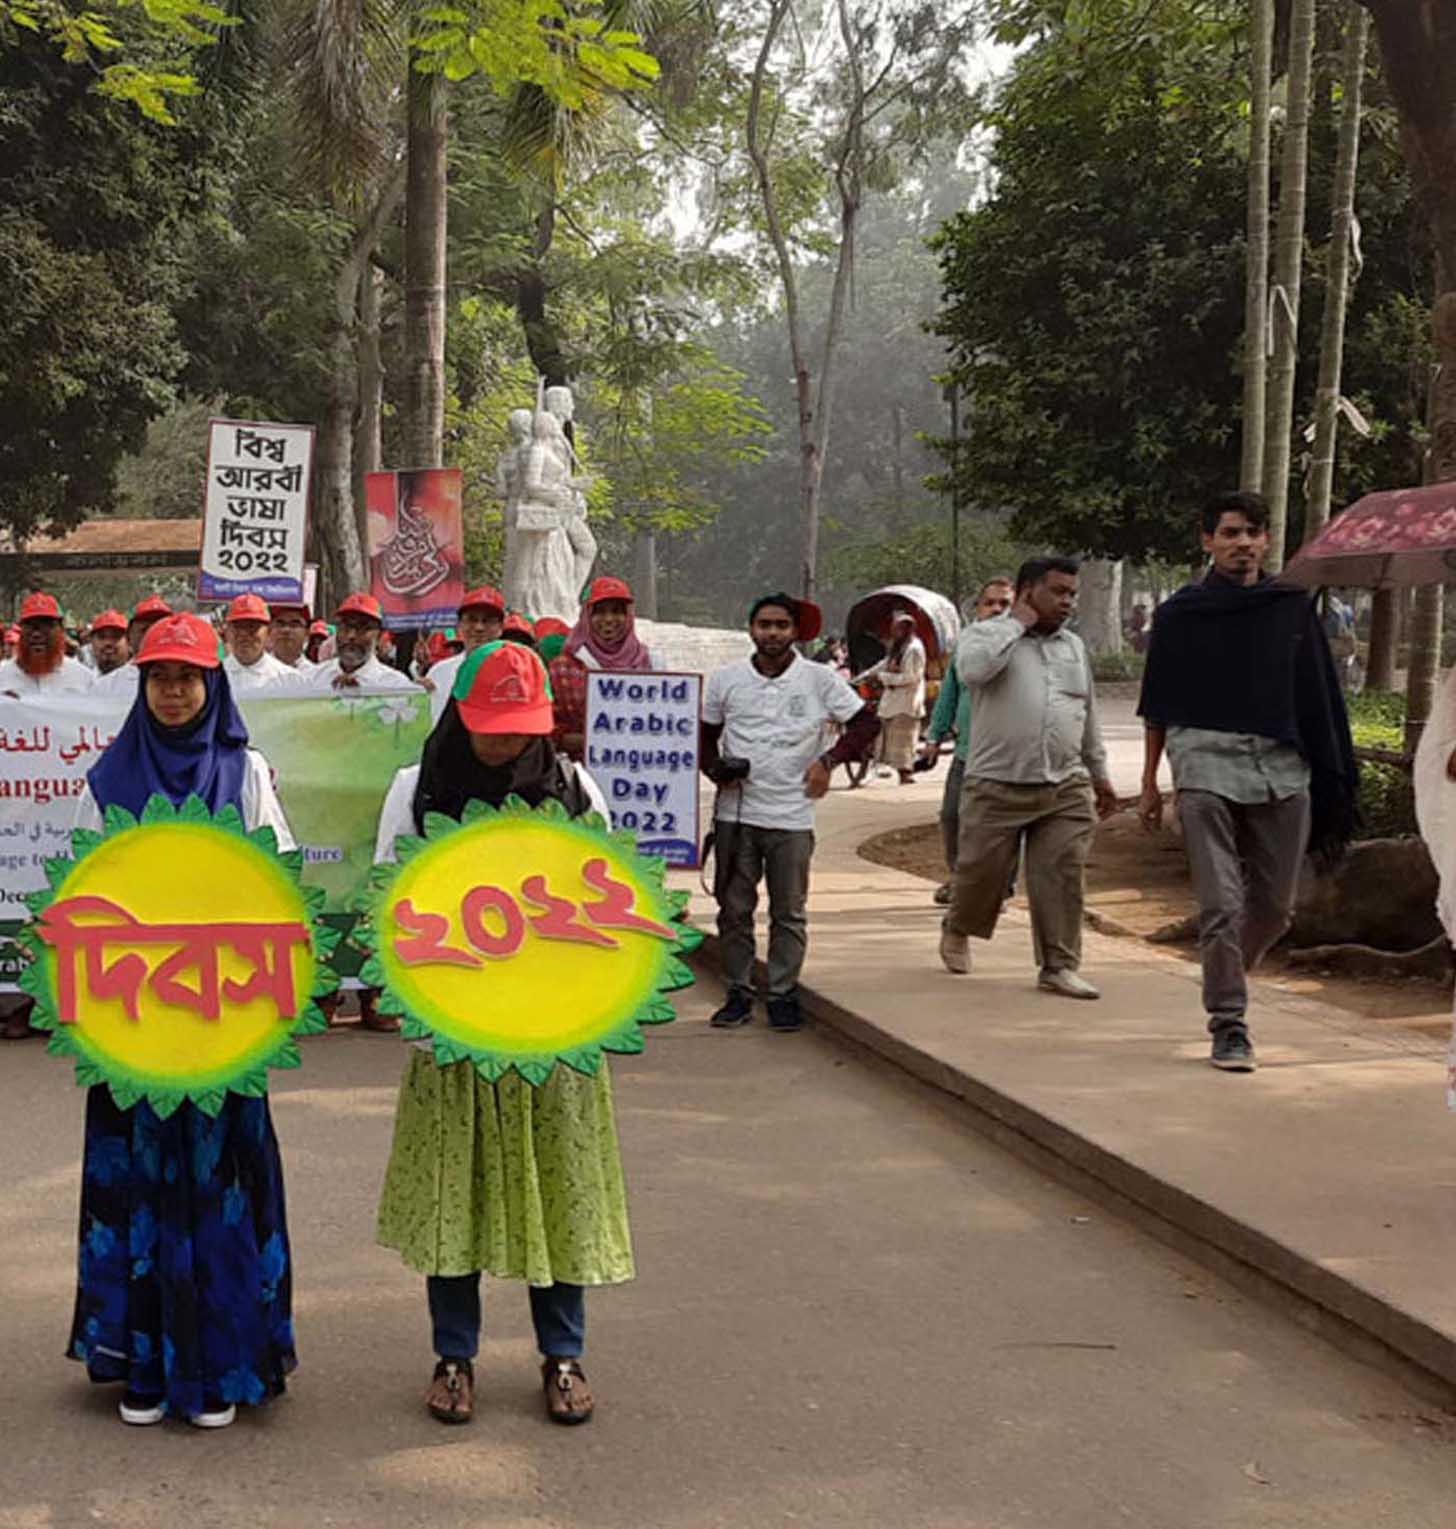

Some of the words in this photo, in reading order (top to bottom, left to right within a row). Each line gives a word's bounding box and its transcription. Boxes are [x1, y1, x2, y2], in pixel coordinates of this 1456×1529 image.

[235, 428, 286, 463] বিশ্ব
[215, 464, 302, 493] আরবী
[226, 495, 288, 520] ভাষা
[220, 518, 288, 549] দিবস
[218, 549, 288, 572] ২০২২
[597, 679, 687, 700] World
[594, 712, 693, 735] Arabic
[588, 746, 694, 772] Language
[613, 778, 667, 805] Day
[393, 858, 677, 969] ২০২২
[38, 896, 310, 1023] দিবস
